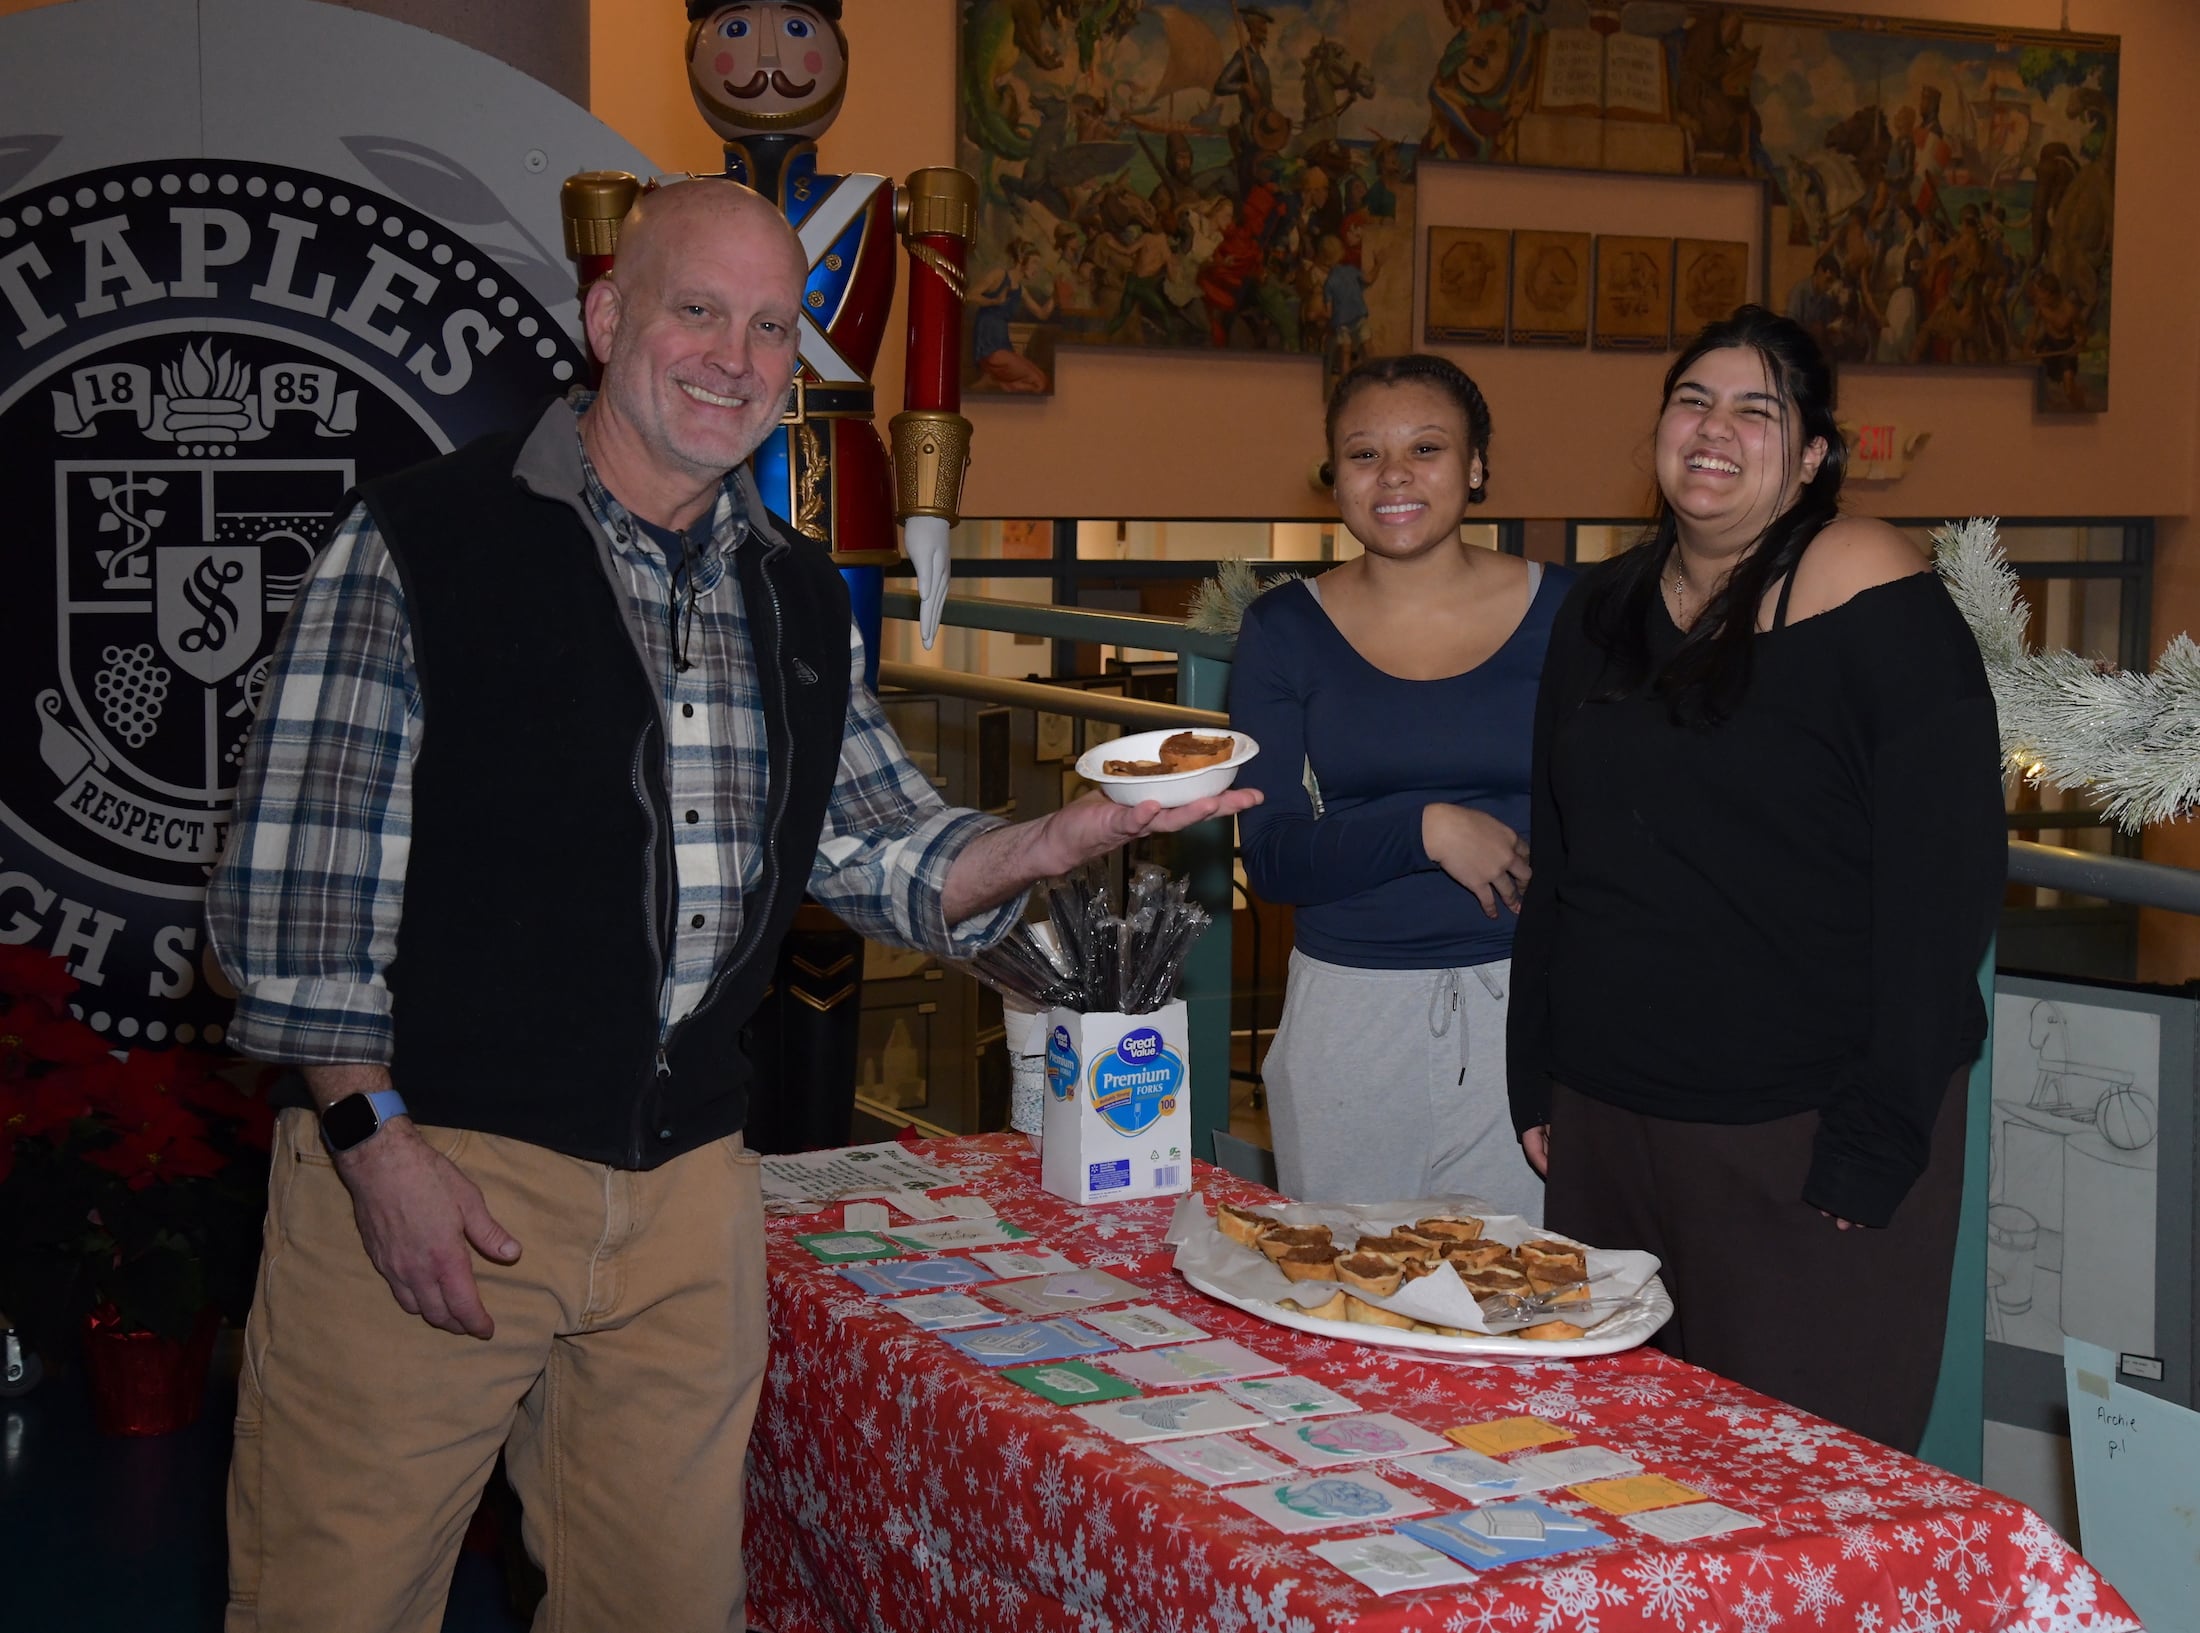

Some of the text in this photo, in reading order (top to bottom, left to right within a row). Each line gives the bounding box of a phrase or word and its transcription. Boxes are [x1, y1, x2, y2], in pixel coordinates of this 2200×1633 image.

[85, 371, 321, 406] 18 85
[1859, 424, 1896, 461] EXIT
[70, 780, 204, 853] RESPECT
[0, 857, 127, 987] GH
[1122, 1035, 1157, 1051] Great
[1131, 1047, 1156, 1058] Value
[1103, 1067, 1171, 1089] Premium
[1136, 1083, 1163, 1095] FORKS
[1160, 1099, 1175, 1110] 100
[2097, 1406, 2137, 1432] Archie
